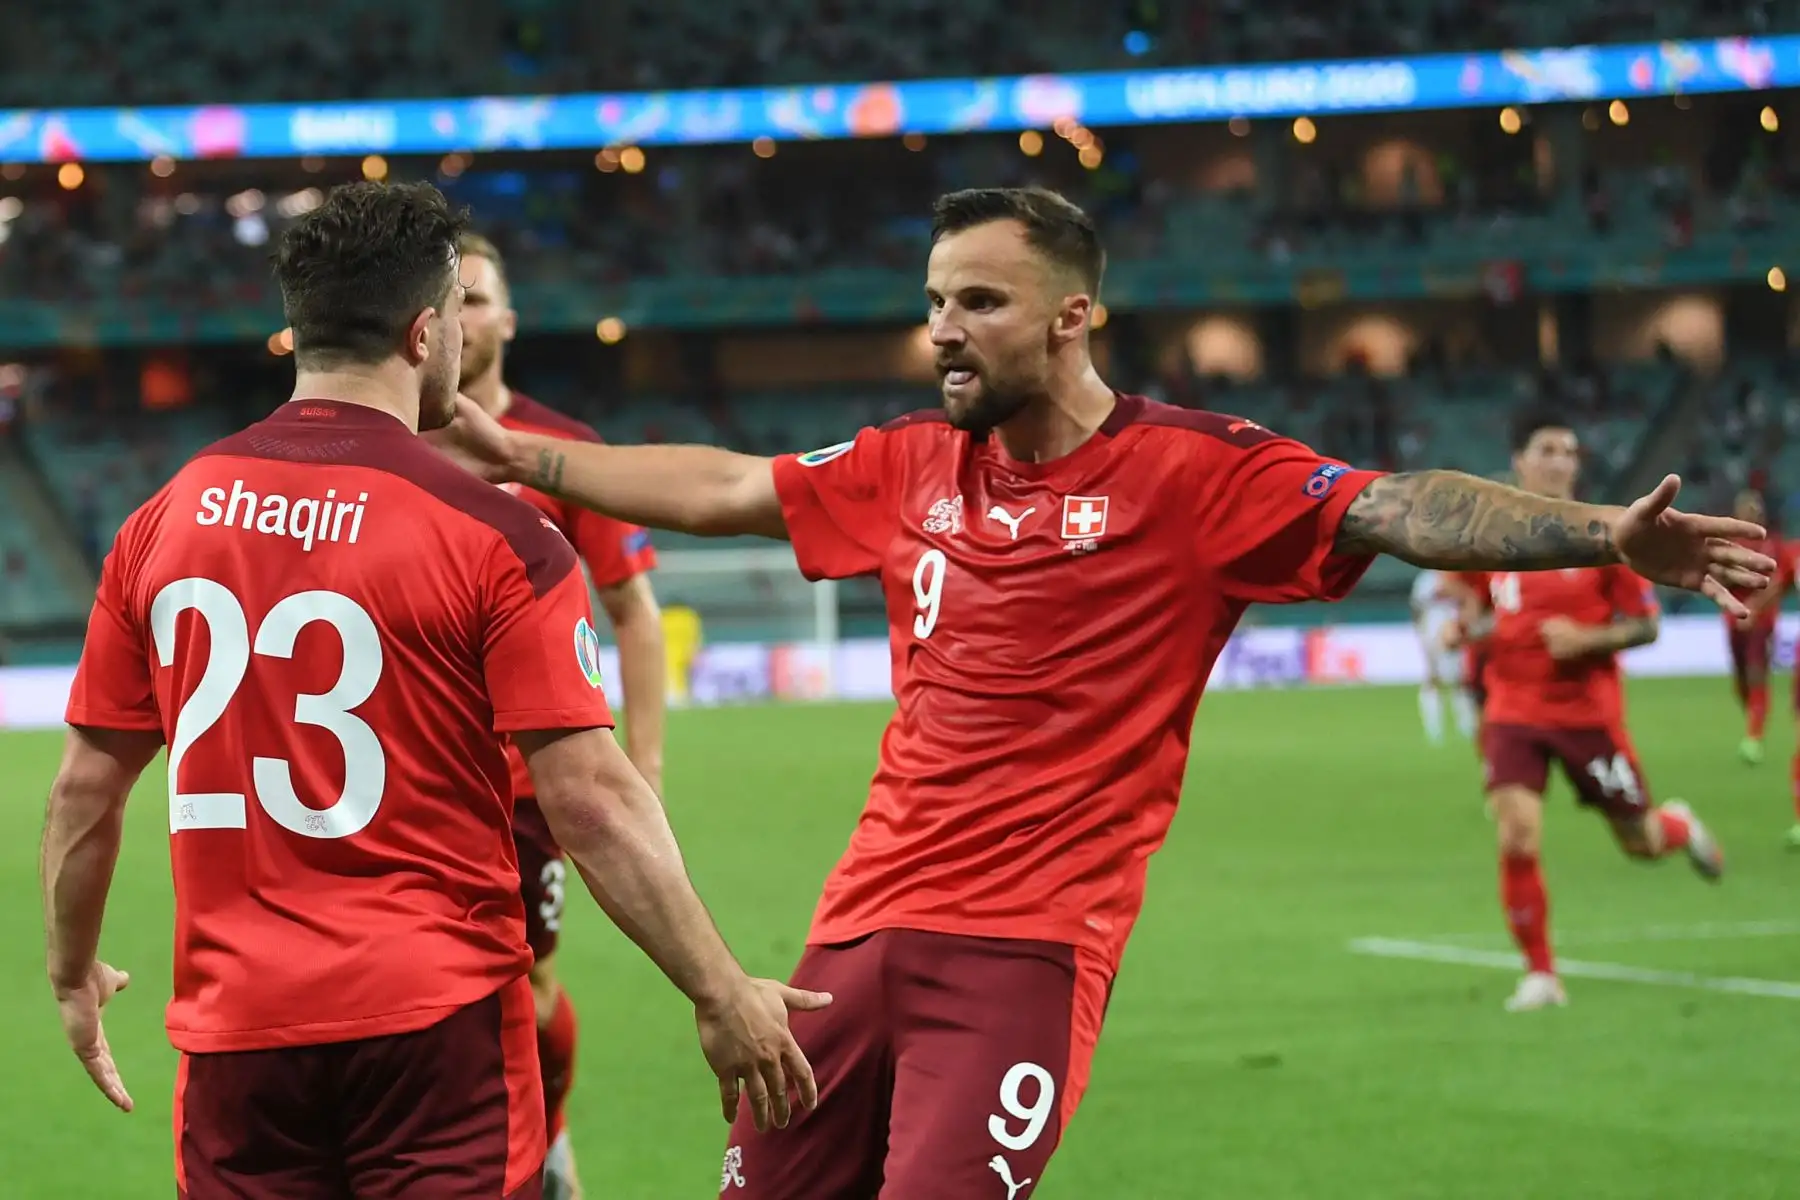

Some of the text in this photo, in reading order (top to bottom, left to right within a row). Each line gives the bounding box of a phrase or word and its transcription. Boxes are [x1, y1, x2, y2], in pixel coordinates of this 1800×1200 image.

[195, 480, 368, 551] shaqiri
[913, 549, 947, 640] 9
[150, 577, 386, 839] 23
[988, 1062, 1056, 1150] 9
